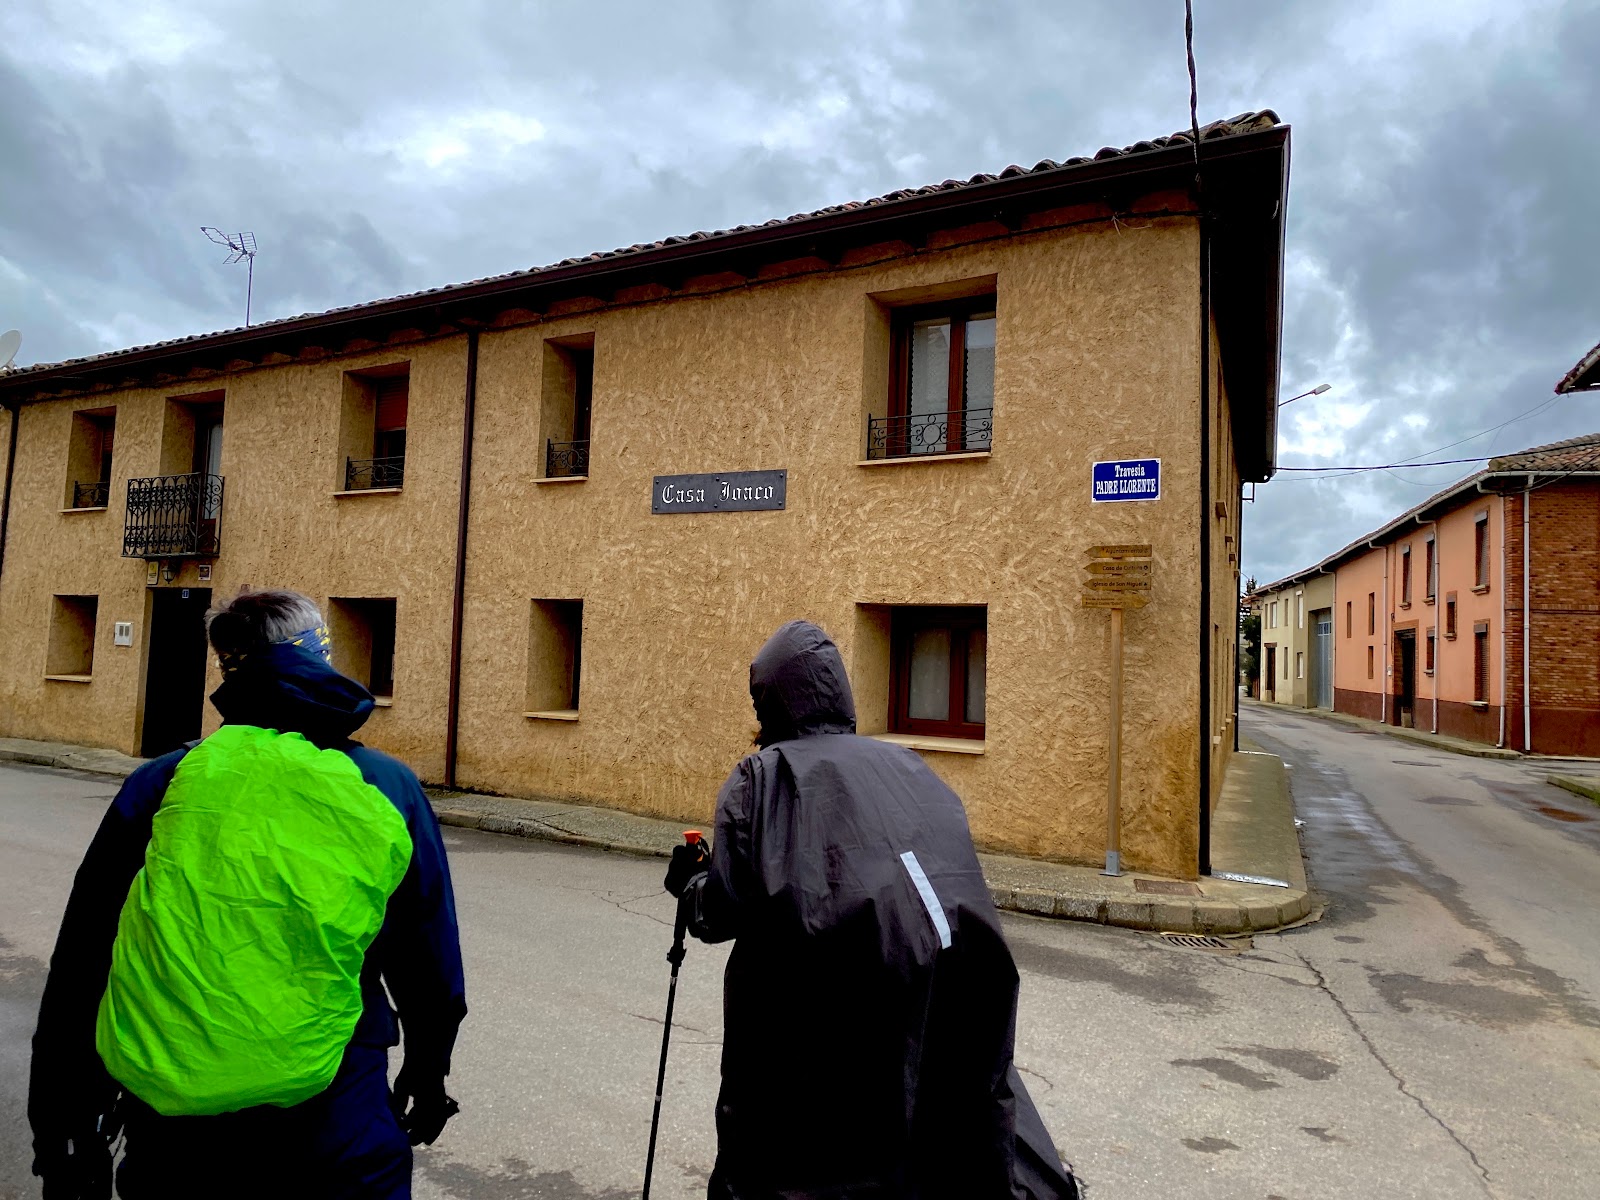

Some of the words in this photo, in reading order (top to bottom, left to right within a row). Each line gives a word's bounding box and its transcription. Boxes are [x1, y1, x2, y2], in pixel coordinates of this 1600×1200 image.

[662, 484, 705, 504] Casa
[1096, 480, 1119, 495] PADRE
[1119, 478, 1156, 494] LLORENTE
